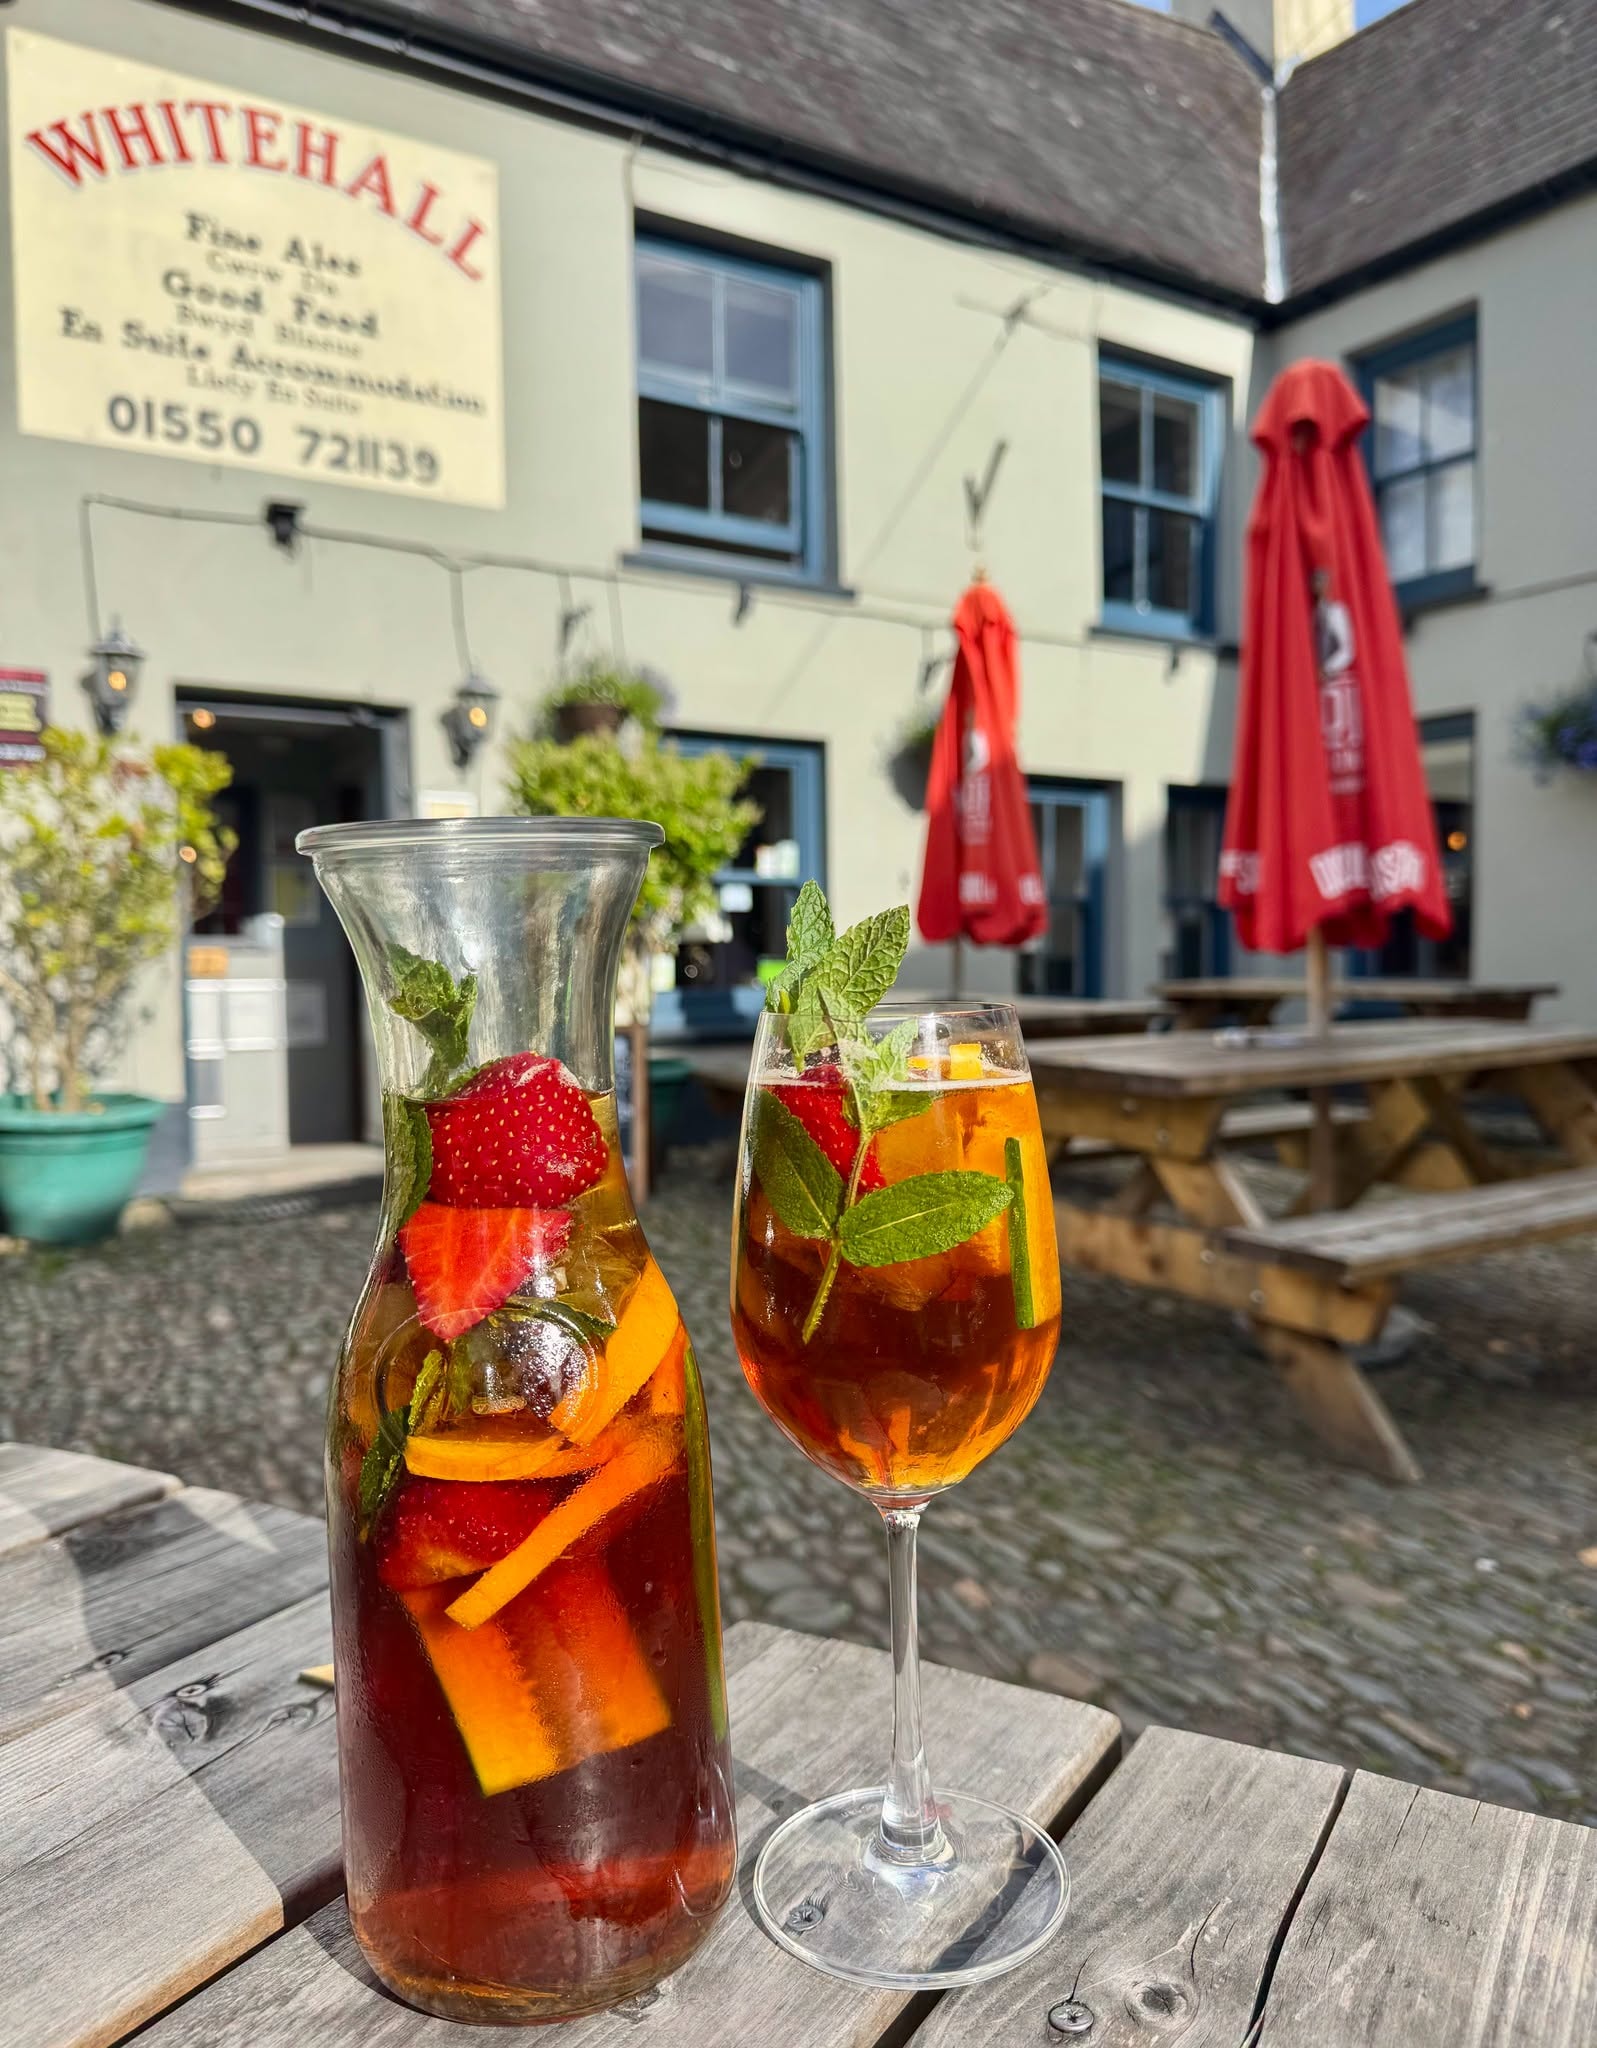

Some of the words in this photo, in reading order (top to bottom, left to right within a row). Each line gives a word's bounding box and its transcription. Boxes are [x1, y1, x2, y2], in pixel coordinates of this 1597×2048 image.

[25, 99, 488, 282] WHITEHALL
[185, 211, 262, 252] Fine
[285, 236, 361, 278] Ales
[162, 268, 263, 315] Good
[293, 296, 379, 339] Food
[108, 396, 262, 455] 01550
[296, 426, 440, 485] 721139
